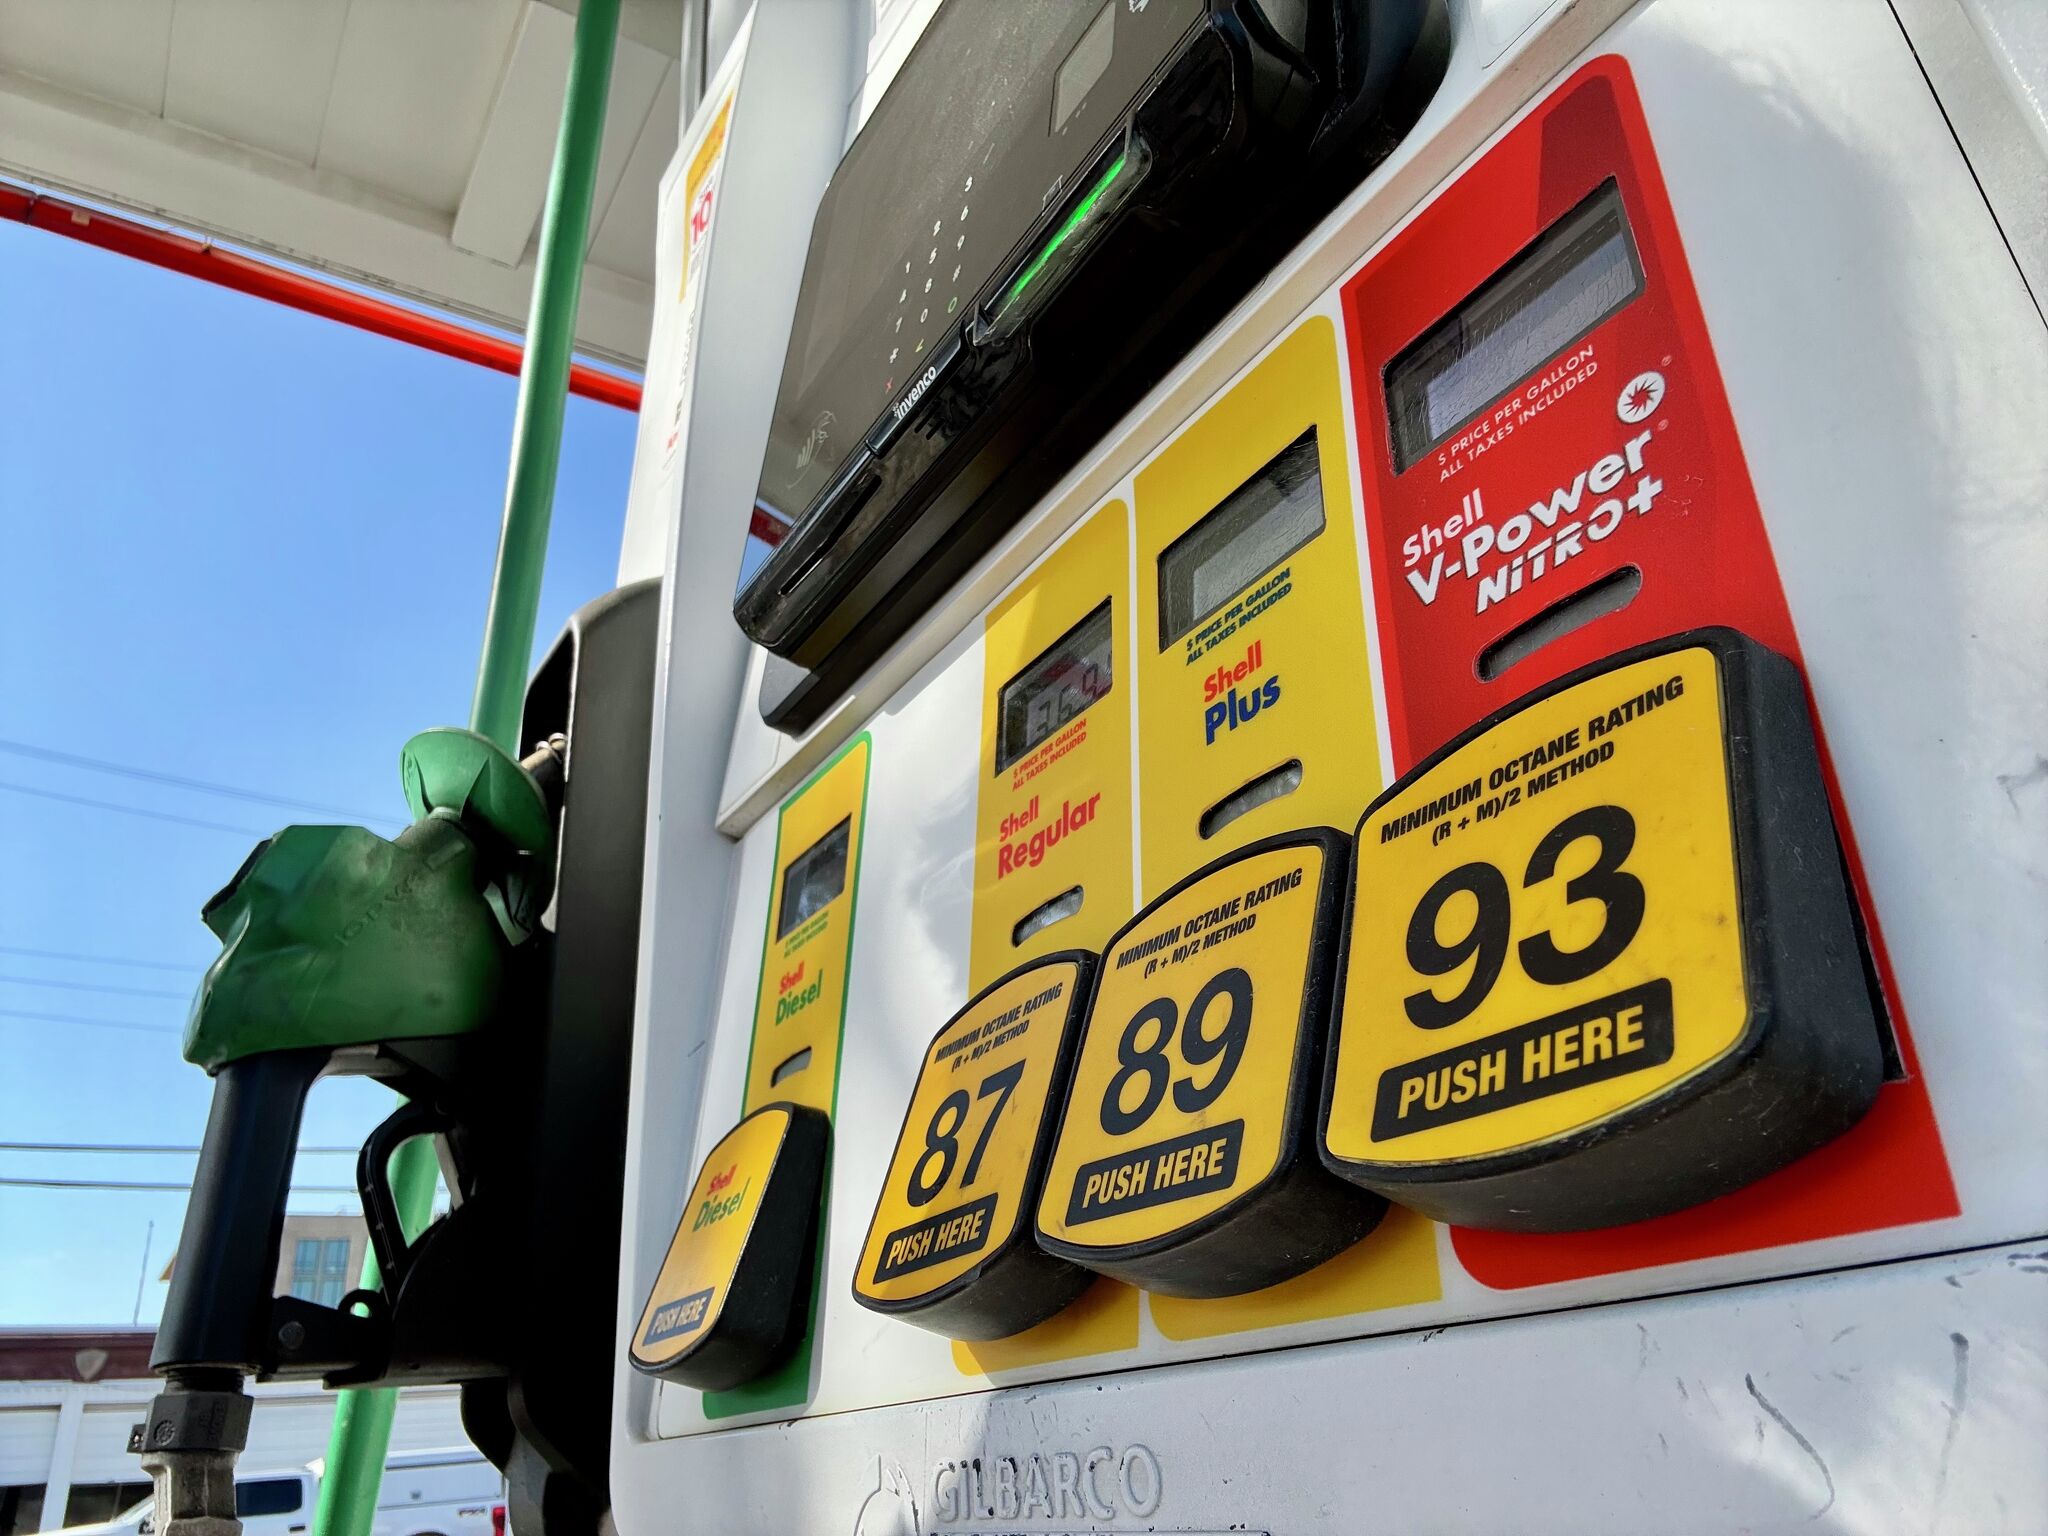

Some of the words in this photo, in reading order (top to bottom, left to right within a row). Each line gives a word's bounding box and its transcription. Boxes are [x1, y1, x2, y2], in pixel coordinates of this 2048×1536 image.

[894, 366, 937, 420] invenco
[1440, 459, 1464, 483] ALL
[1467, 422, 1514, 462] TAXES
[1518, 361, 1598, 425] INCLUDED
[1451, 420, 1490, 457] PRICE
[1494, 398, 1522, 425] PER
[1526, 344, 1594, 400] GALLON
[1402, 487, 1484, 567] Shell
[1406, 430, 1652, 606] V-Power
[1186, 647, 1204, 666] ALL
[1205, 622, 1237, 651] TAXES
[1239, 582, 1293, 628] INCLUDED
[1195, 617, 1223, 645] PRICE
[1224, 602, 1244, 623] PER
[1245, 567, 1291, 607] GALLON
[1204, 639, 1262, 703] Shell
[1049, 731, 1087, 765] INCLUDED
[1055, 718, 1087, 748] GALLON
[1205, 675, 1281, 746] Plus
[1380, 777, 1482, 844] MINIMUM
[1488, 728, 1580, 790] OCTANE
[1588, 675, 1684, 742] RATING
[1432, 818, 1451, 847] (R
[1476, 787, 1521, 824] M)/2
[1527, 740, 1615, 797] METHOD
[998, 792, 1101, 880] Regular
[1000, 795, 1040, 842] Shell
[1116, 925, 1181, 970] MINIMUM
[1183, 897, 1241, 938] OCTANE
[1244, 868, 1302, 911] RATING
[1144, 958, 1157, 979] (R
[1171, 939, 1201, 964] M)/2
[1202, 914, 1257, 950] METHOD
[1404, 804, 1646, 1030] 93
[776, 968, 823, 1026] Diesel
[779, 960, 805, 995] Shell
[934, 1027, 981, 1064] MINIMUM
[982, 1005, 1022, 1038] OCTANE
[1022, 982, 1063, 1017] RATING
[992, 1020, 1030, 1050] METHOD
[1100, 967, 1253, 1136] 89
[1397, 1048, 1508, 1120] PUSH
[1522, 1005, 1645, 1084] HERE
[907, 1058, 1027, 1208] 87
[692, 1177, 751, 1232] Diesel
[707, 1164, 737, 1196] Shell
[1082, 1164, 1150, 1209] PUSH
[1153, 1137, 1228, 1190] HERE
[885, 1226, 932, 1269] PUSH
[935, 1209, 986, 1247] HERE
[651, 1306, 677, 1336] PUSH
[676, 1296, 708, 1328] HERE
[934, 1443, 1163, 1522] GILBARCO
